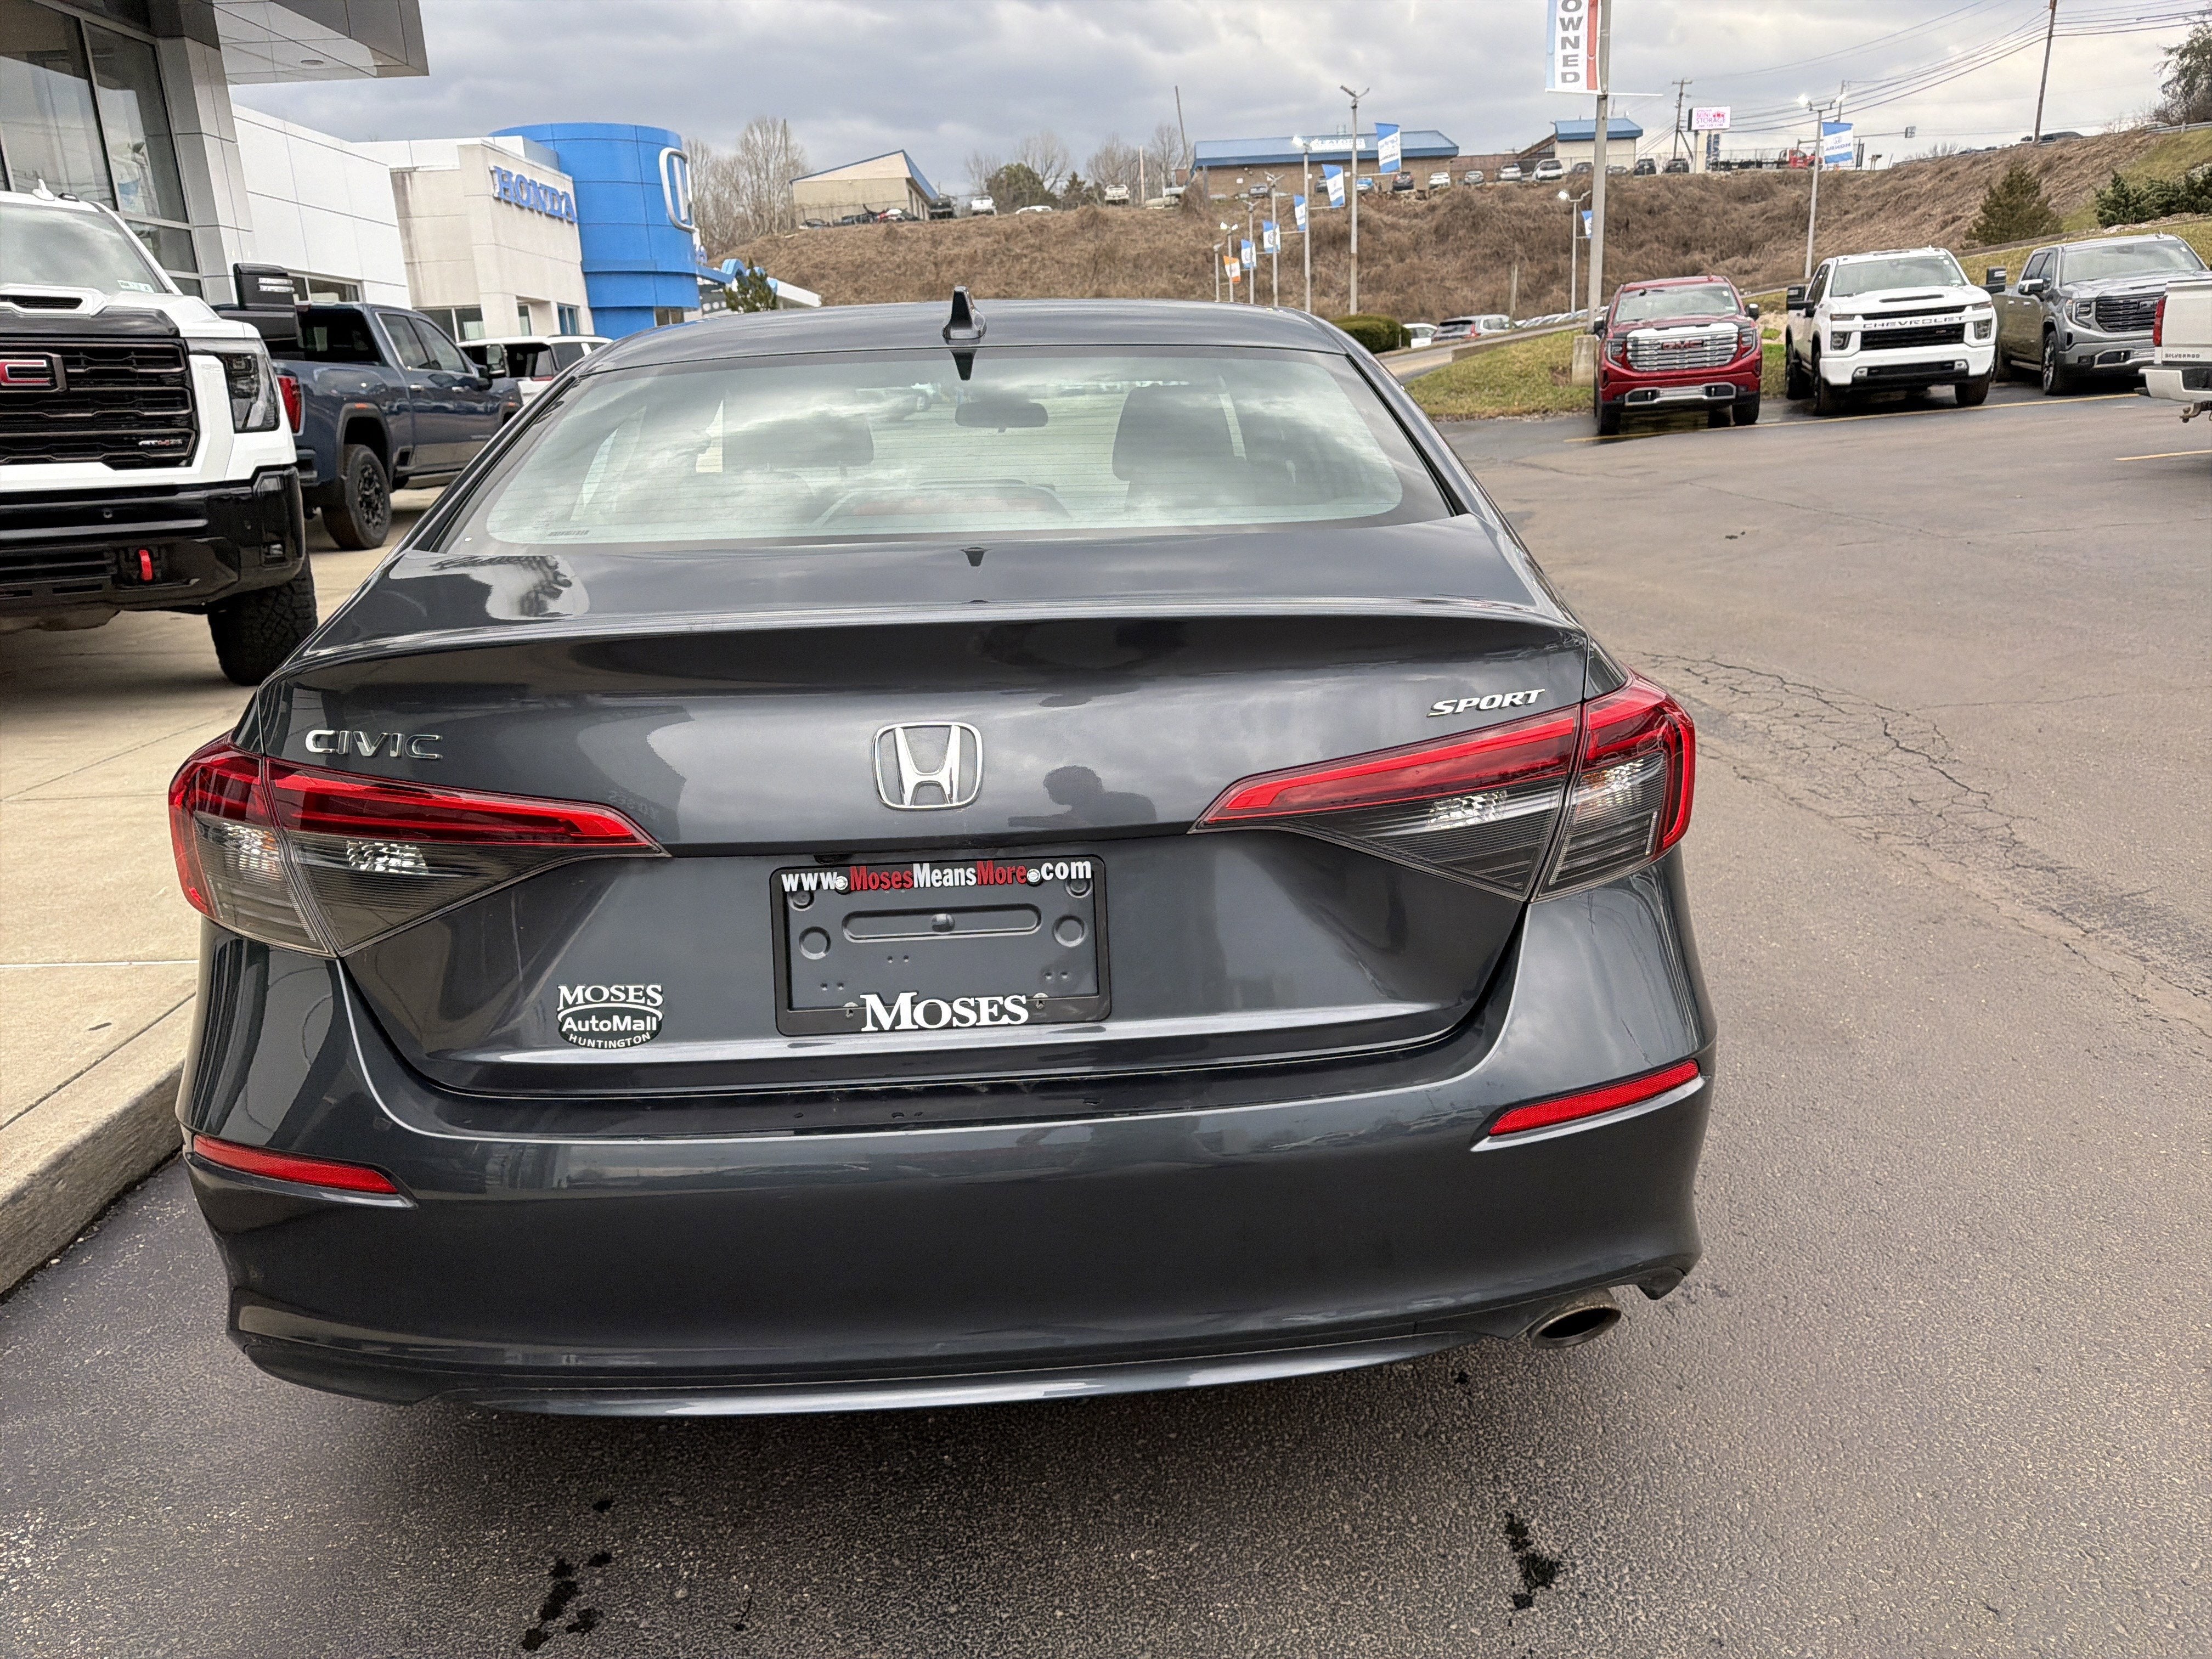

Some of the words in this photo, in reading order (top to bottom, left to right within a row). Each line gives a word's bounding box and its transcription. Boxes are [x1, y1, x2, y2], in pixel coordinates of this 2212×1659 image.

[1559, 0, 1583, 83] OWNED
[489, 166, 577, 223] HONDA
[1863, 315, 1966, 329] CHEVROLET
[1662, 340, 1703, 349] GMC
[1426, 689, 1545, 718] SPORT
[306, 730, 443, 759] CIVIC
[557, 984, 663, 1012] MOSES
[860, 991, 1029, 1032] MOSES
[561, 1015, 657, 1032] AutoMall
[568, 1031, 651, 1048] HUNTINGTON
